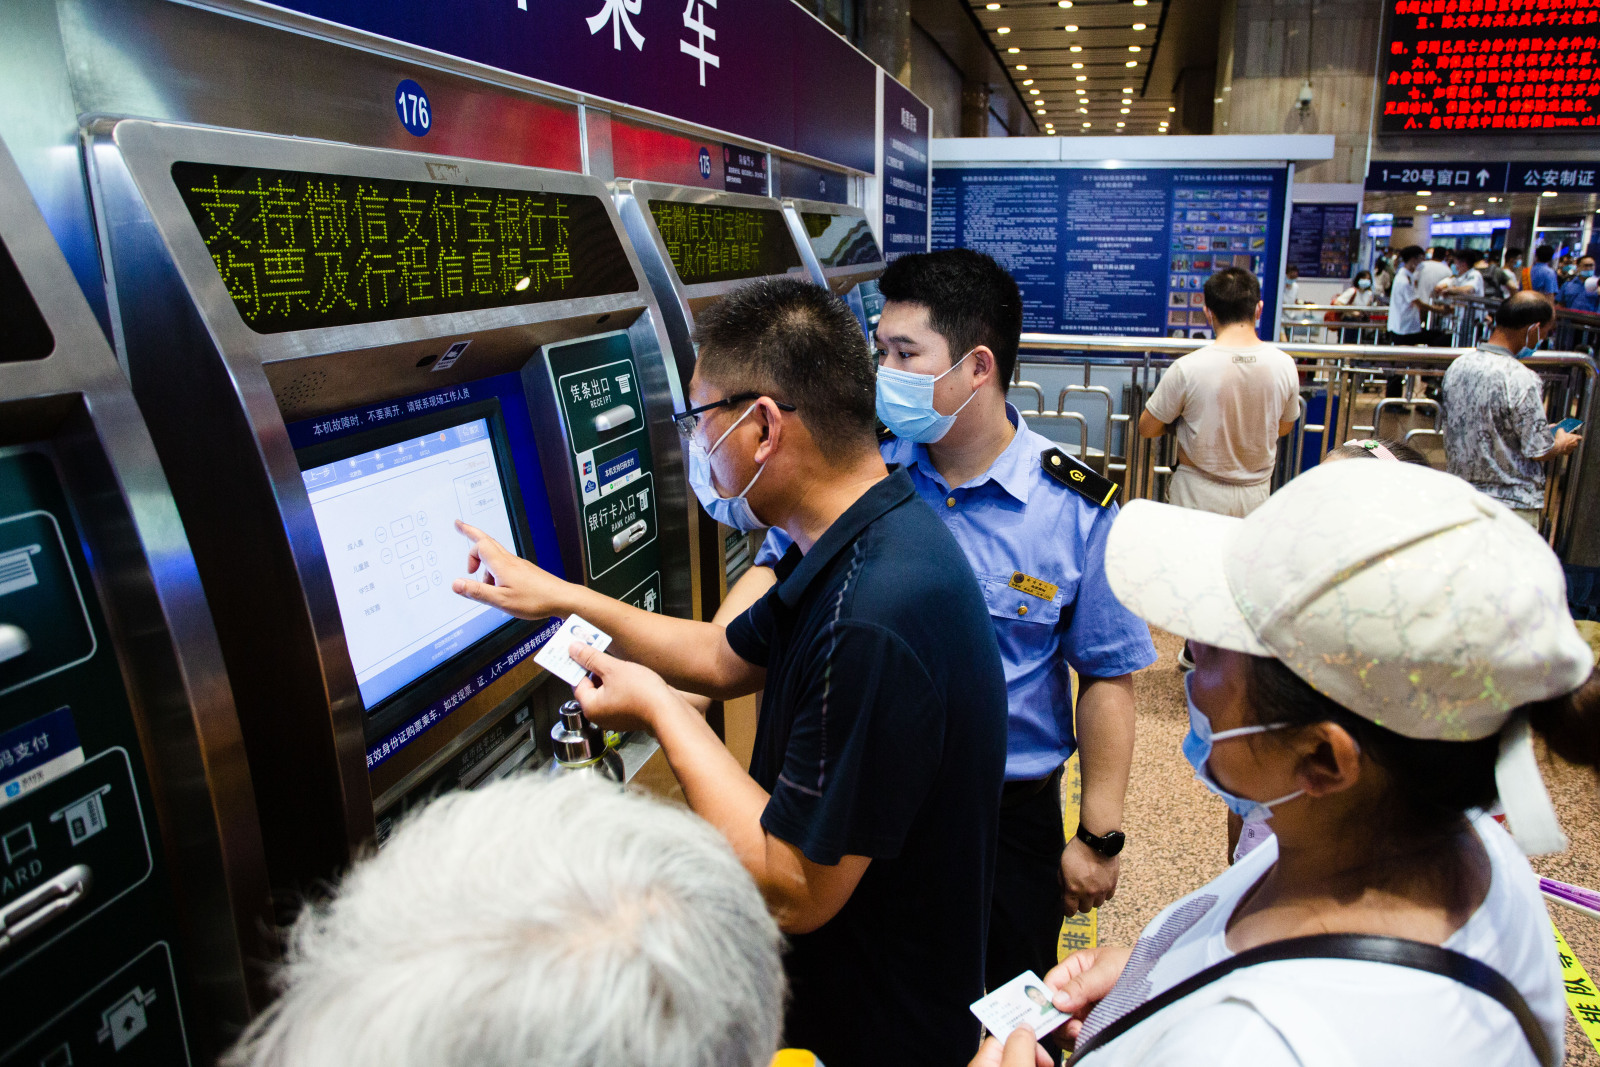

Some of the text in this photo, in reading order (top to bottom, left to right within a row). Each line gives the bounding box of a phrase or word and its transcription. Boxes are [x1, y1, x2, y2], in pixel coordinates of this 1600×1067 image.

[398, 92, 430, 129] 176
[699, 155, 711, 174] 175
[1382, 169, 1470, 186] 1-20号窗口
[1523, 169, 1595, 187] 公安制证
[191, 174, 571, 248] 支持微信支付宝银行卡
[651, 203, 764, 242] 持微信支付宝银行卡
[212, 245, 573, 320] 购票及行程信息提示单
[570, 377, 610, 403] 凭条出口
[590, 394, 612, 409] RECEIPT
[588, 494, 636, 532] 银行卡入口
[611, 511, 636, 532] BANK CARD
